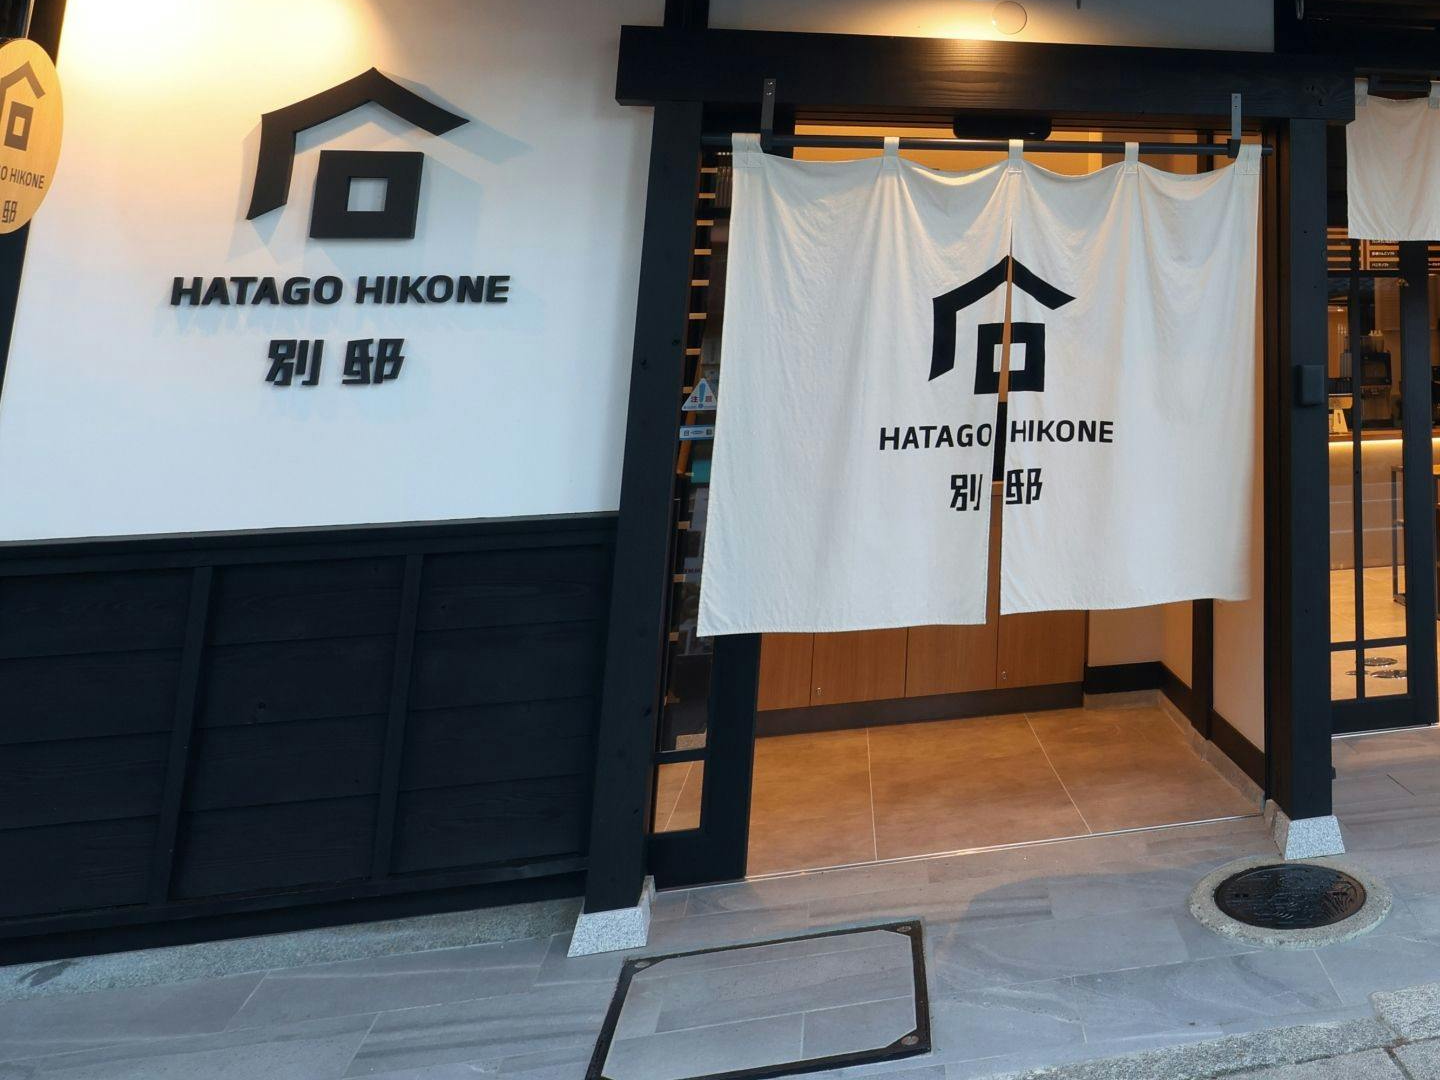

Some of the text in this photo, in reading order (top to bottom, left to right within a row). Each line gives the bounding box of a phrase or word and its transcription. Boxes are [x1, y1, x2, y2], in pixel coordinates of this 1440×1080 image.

[10, 167, 45, 189] HIKONE
[170, 274, 511, 306] HATAGO HIKONE
[265, 338, 406, 386] 別邸
[879, 420, 1113, 451] HATAGO HIKONE
[950, 468, 1043, 512] 別邸
